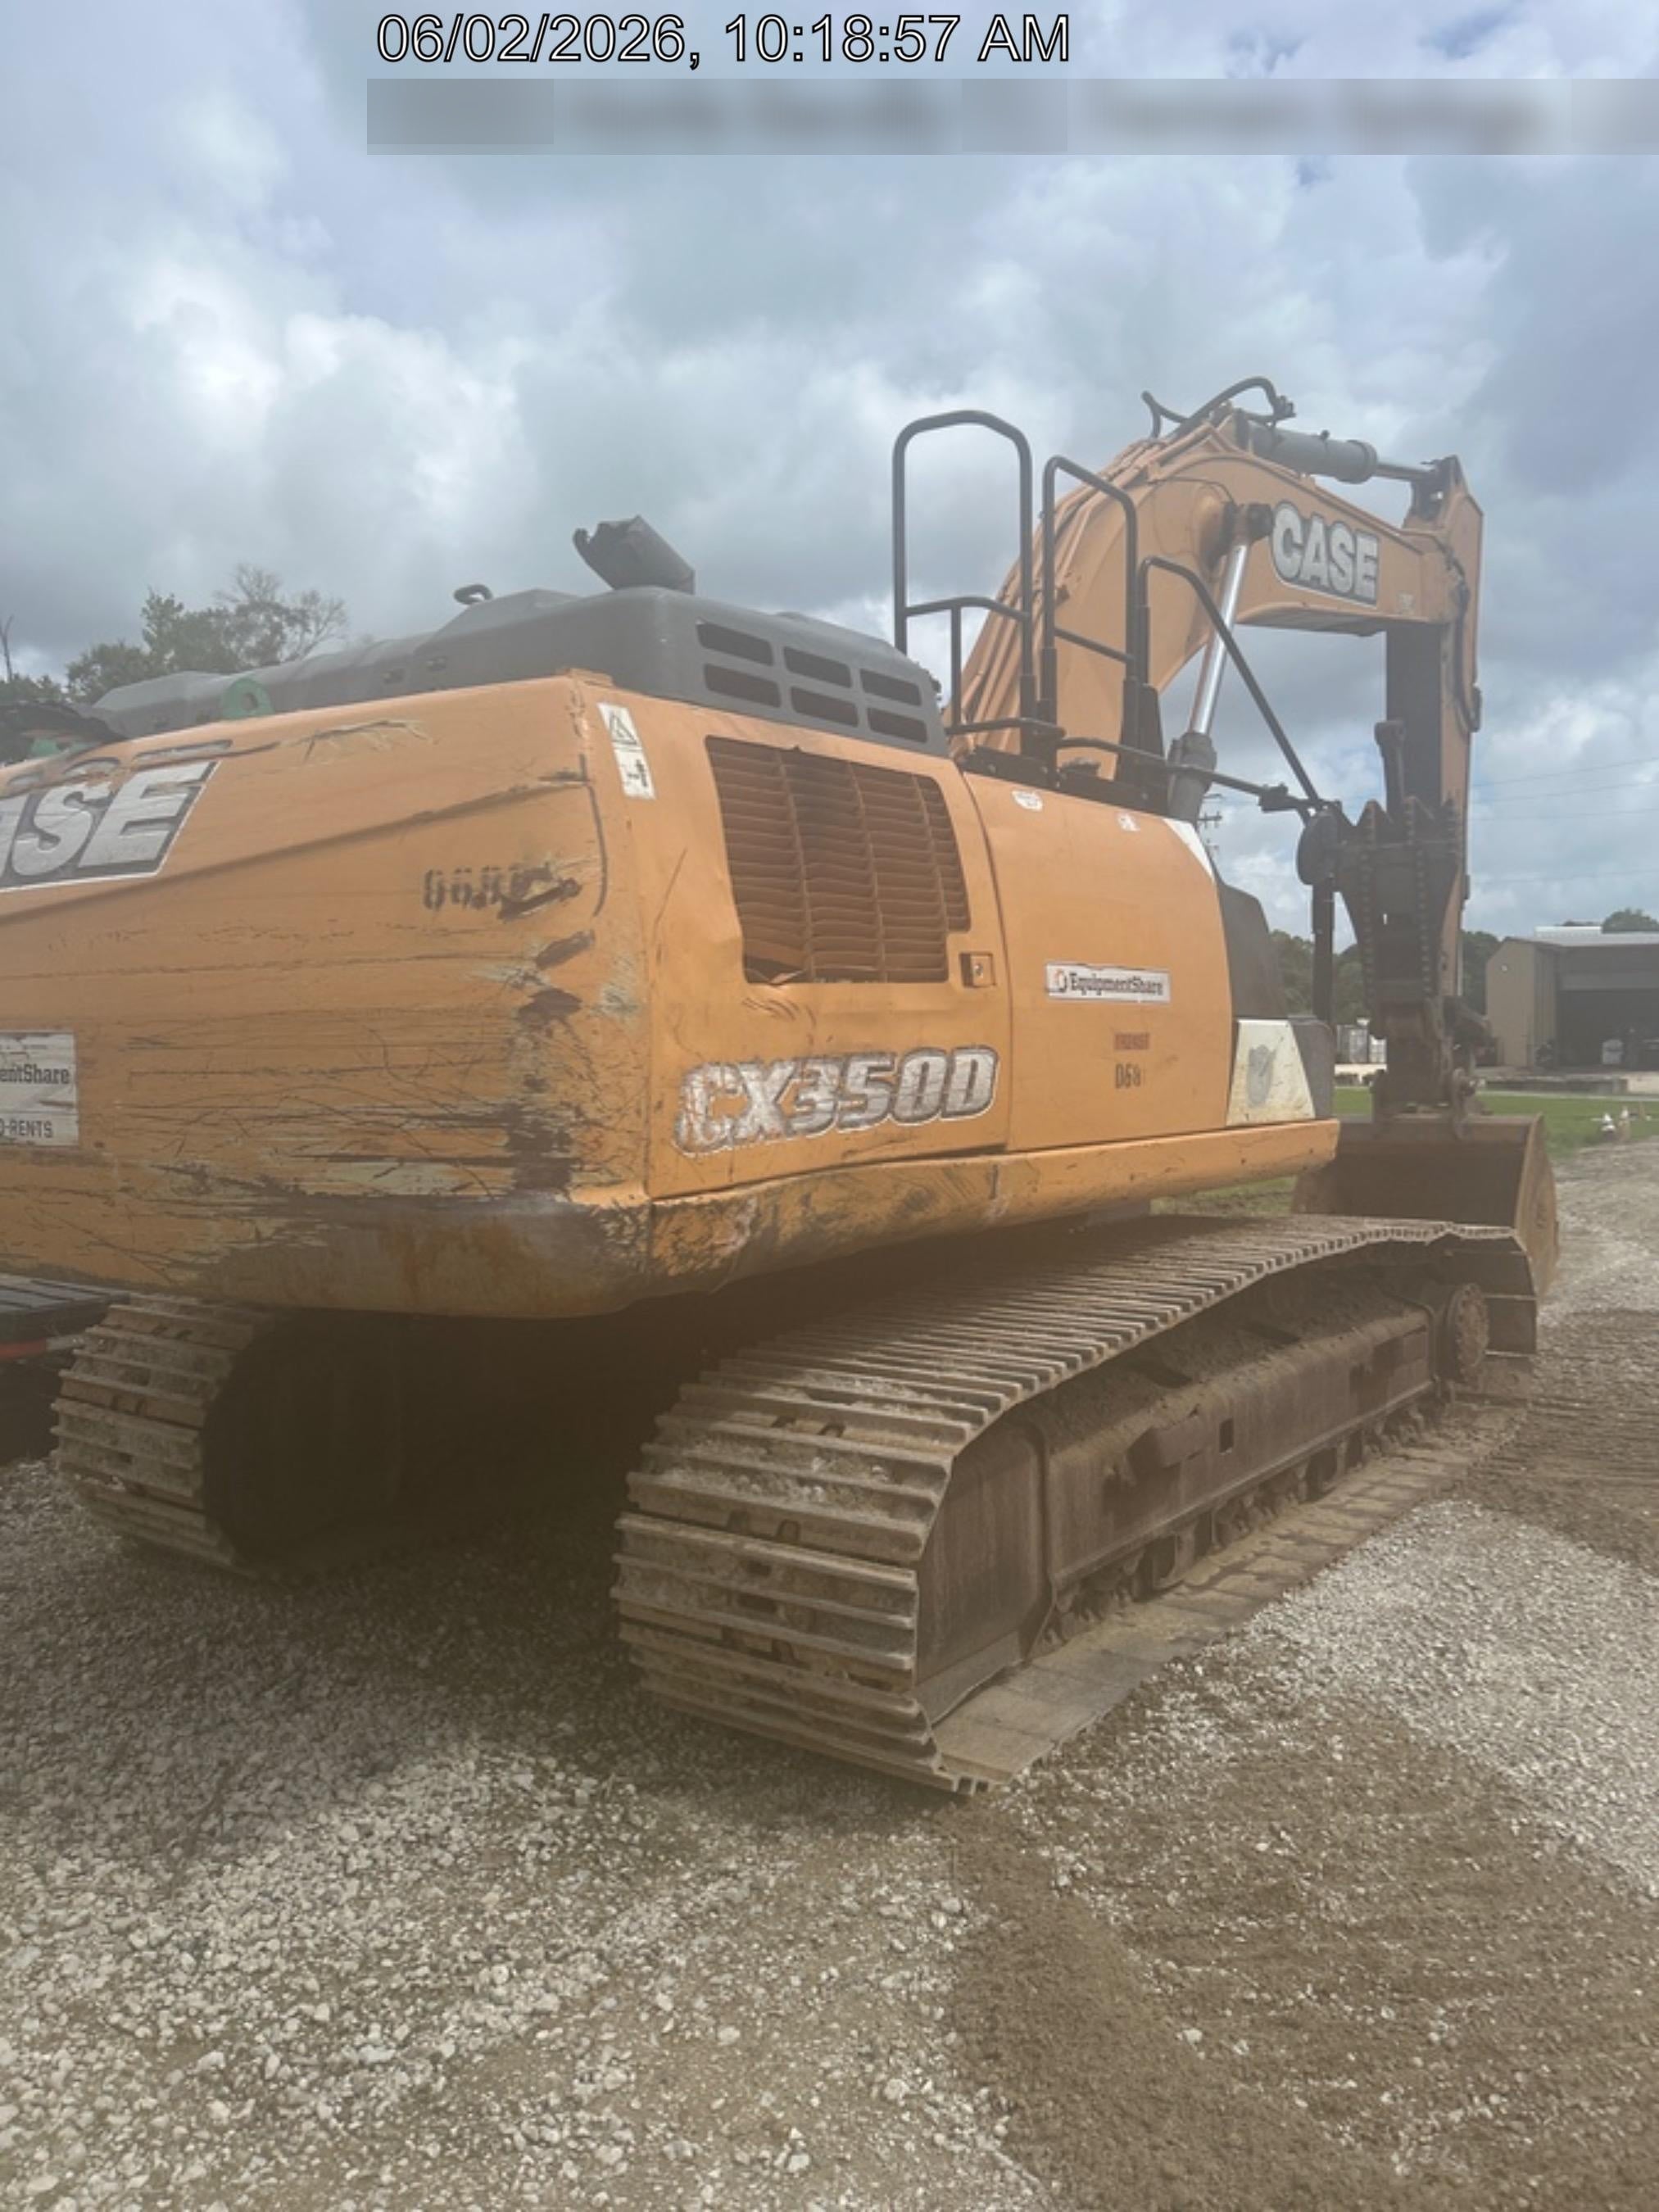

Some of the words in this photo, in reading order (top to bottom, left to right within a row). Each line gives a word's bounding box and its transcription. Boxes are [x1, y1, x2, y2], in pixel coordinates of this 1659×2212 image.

[1272, 501, 1379, 605] CASE
[1069, 972, 1164, 996] EquipmentShare
[673, 1044, 999, 1157] CX350D
